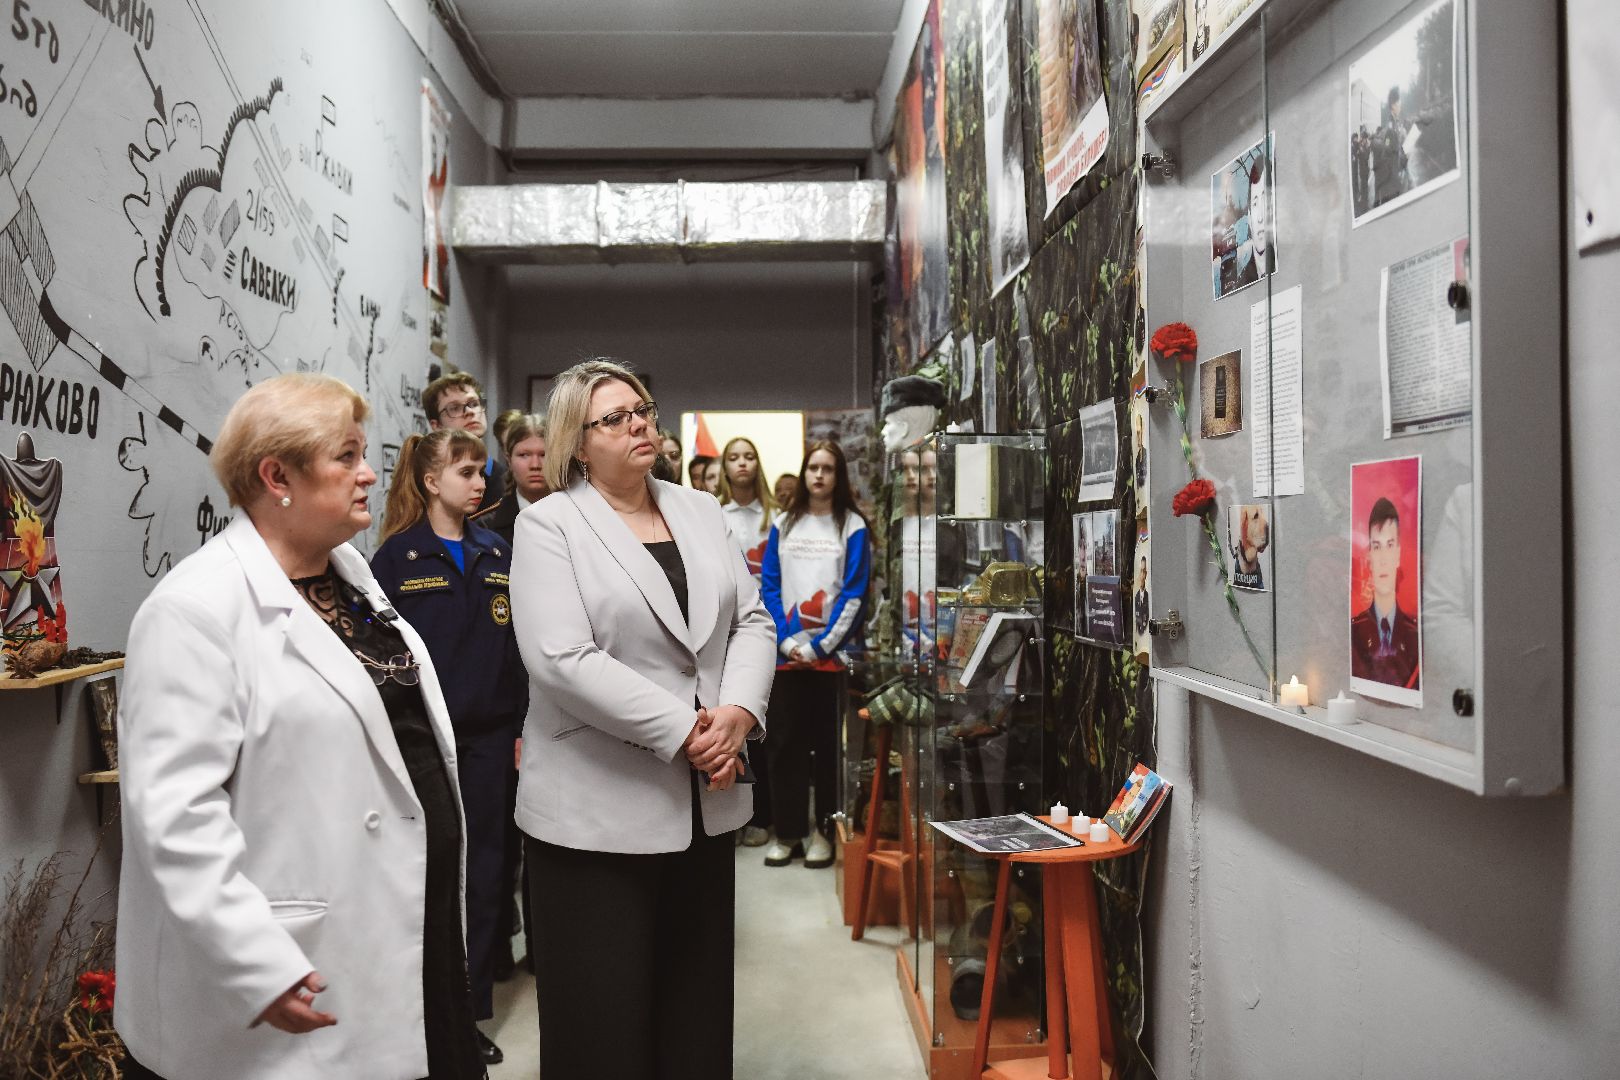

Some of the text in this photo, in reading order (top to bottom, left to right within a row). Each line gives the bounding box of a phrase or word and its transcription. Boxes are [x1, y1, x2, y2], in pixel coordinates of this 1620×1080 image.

[240, 245, 296, 310] САВЕЛКИ
[0, 362, 100, 440] РЮКОВО
[197, 494, 234, 546] Фир
